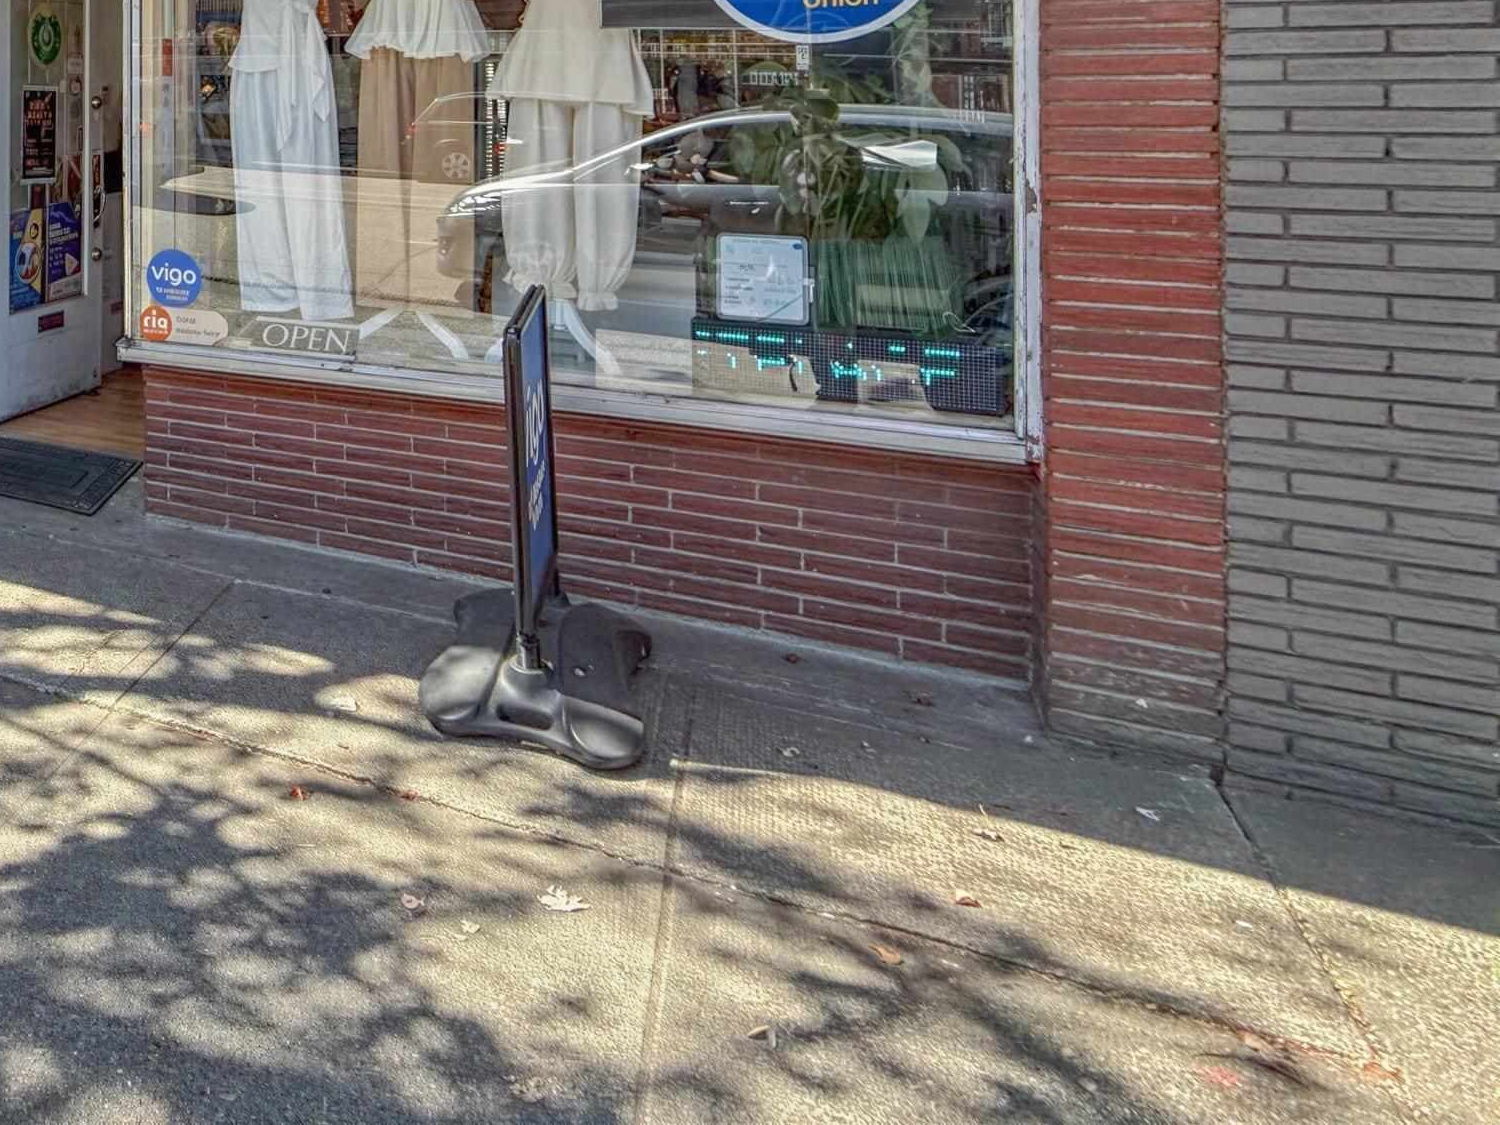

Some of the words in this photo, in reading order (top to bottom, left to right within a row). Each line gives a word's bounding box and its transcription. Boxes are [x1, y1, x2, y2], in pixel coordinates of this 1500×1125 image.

[151, 262, 197, 287] vigo
[143, 309, 168, 329] ria
[262, 323, 351, 353] OPEN
